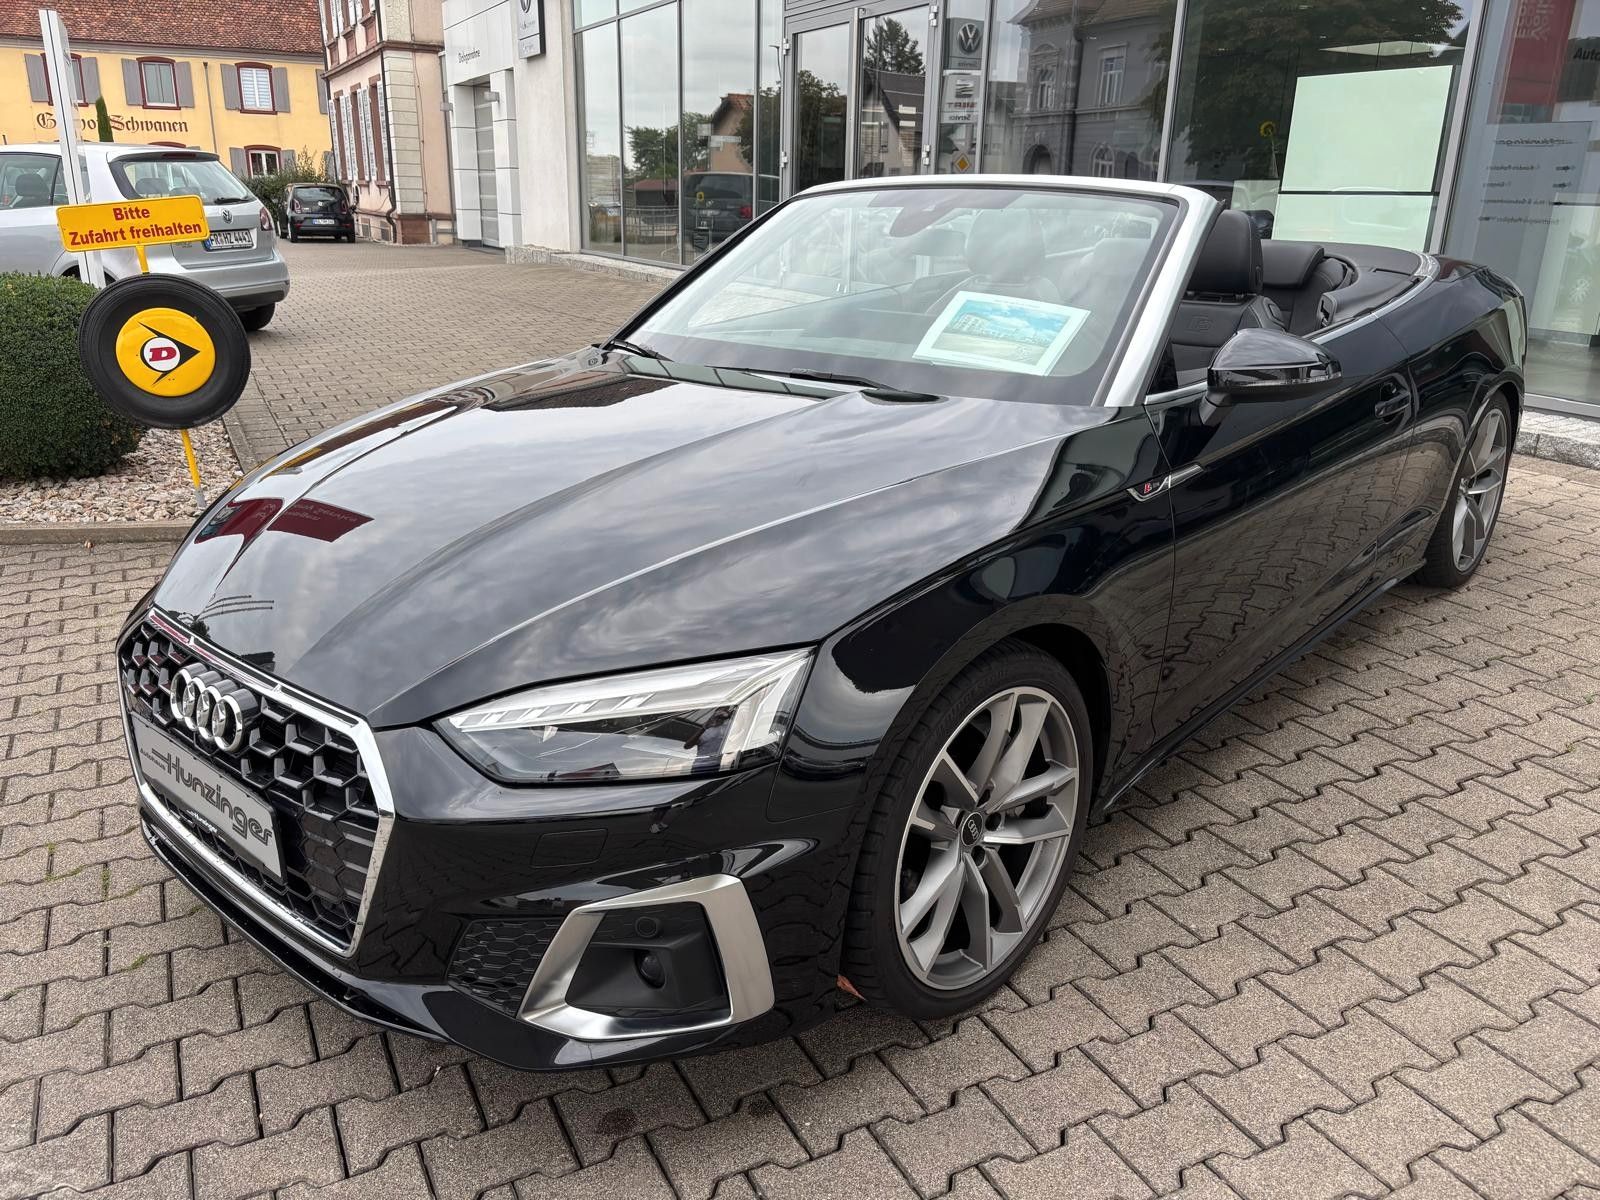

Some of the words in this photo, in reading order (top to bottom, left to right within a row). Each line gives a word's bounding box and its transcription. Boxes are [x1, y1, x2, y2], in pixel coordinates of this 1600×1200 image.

[109, 114, 188, 133] Schwanen
[112, 206, 150, 221] Bitte
[69, 228, 127, 246] Zufahrt
[129, 222, 202, 239] freihalten
[149, 346, 177, 362] D
[152, 748, 272, 846] Hunzinger
